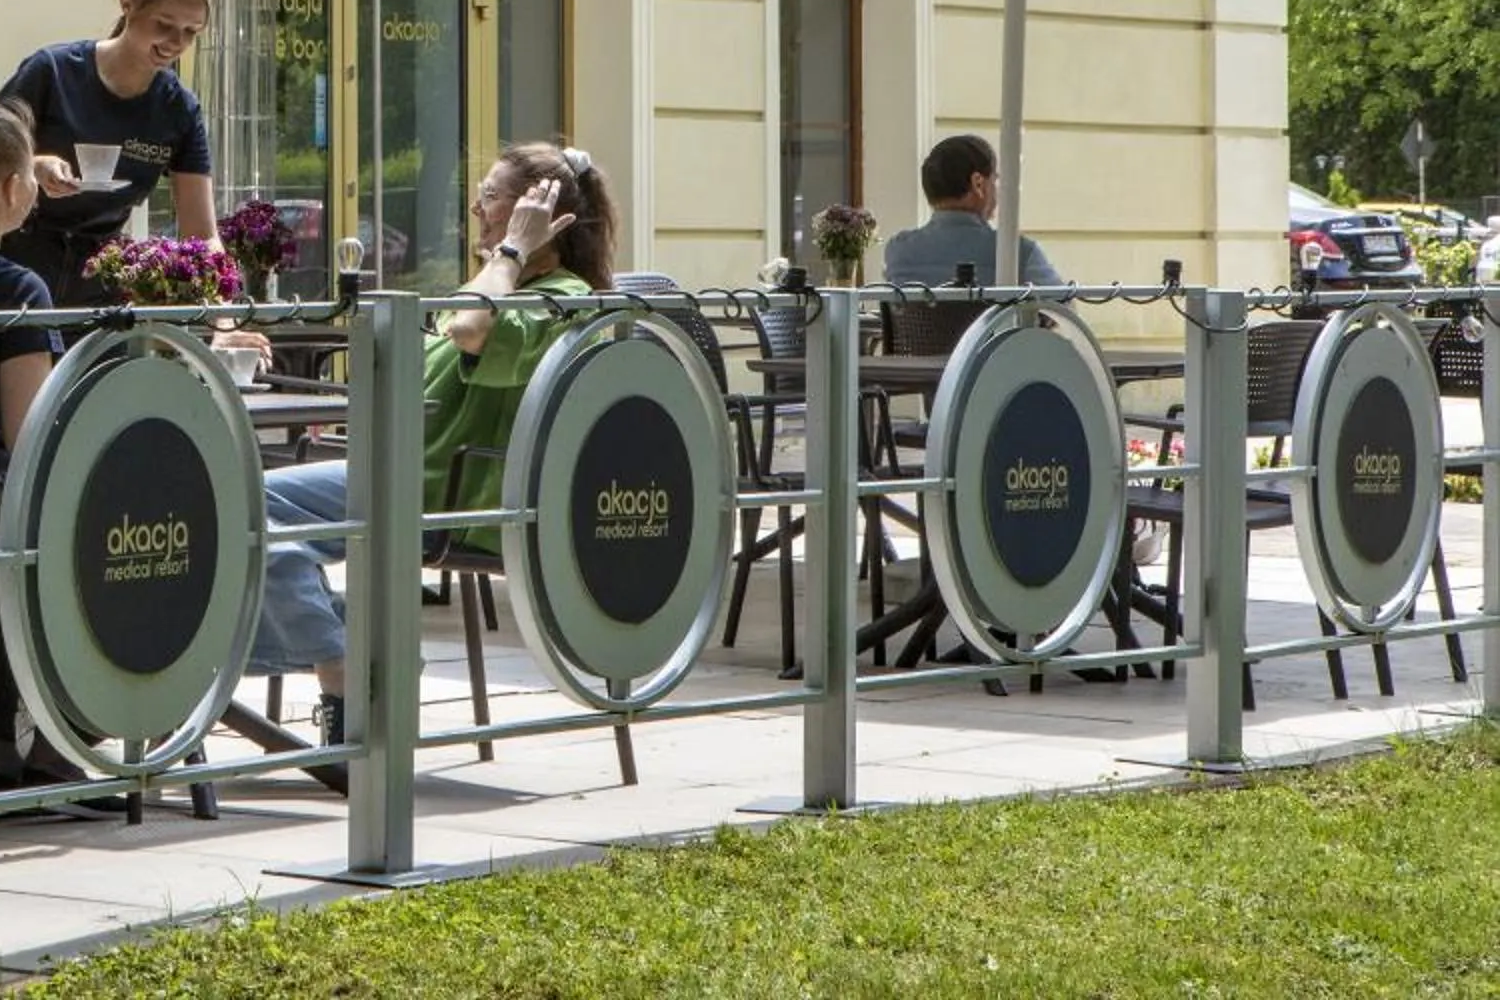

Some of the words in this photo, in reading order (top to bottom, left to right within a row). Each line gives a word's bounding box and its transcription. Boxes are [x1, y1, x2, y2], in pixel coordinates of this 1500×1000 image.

[1007, 456, 1068, 497] akacja
[597, 478, 668, 525] akacja
[107, 512, 189, 560] akacja
[104, 559, 152, 581] medical
[154, 554, 190, 576] resort
